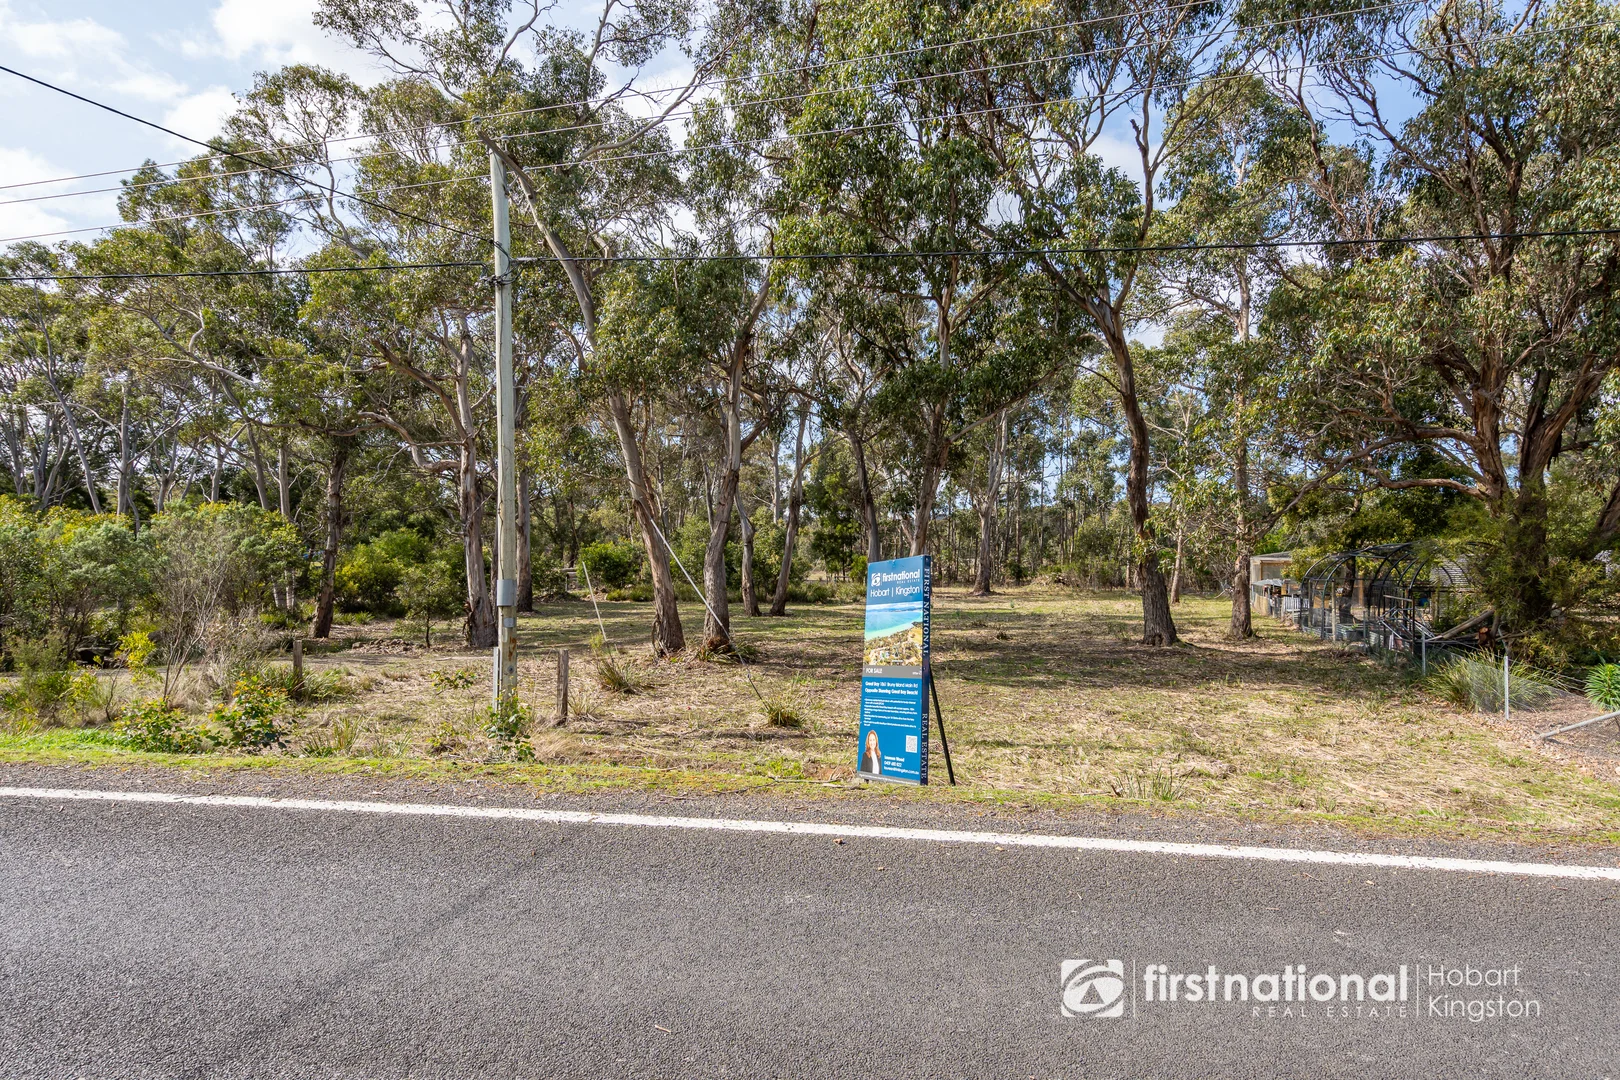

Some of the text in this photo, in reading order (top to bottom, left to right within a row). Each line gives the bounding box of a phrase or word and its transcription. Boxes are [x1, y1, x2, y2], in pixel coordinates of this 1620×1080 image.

[882, 569, 920, 582] firstnational
[870, 586, 920, 597] Hobart Kingston
